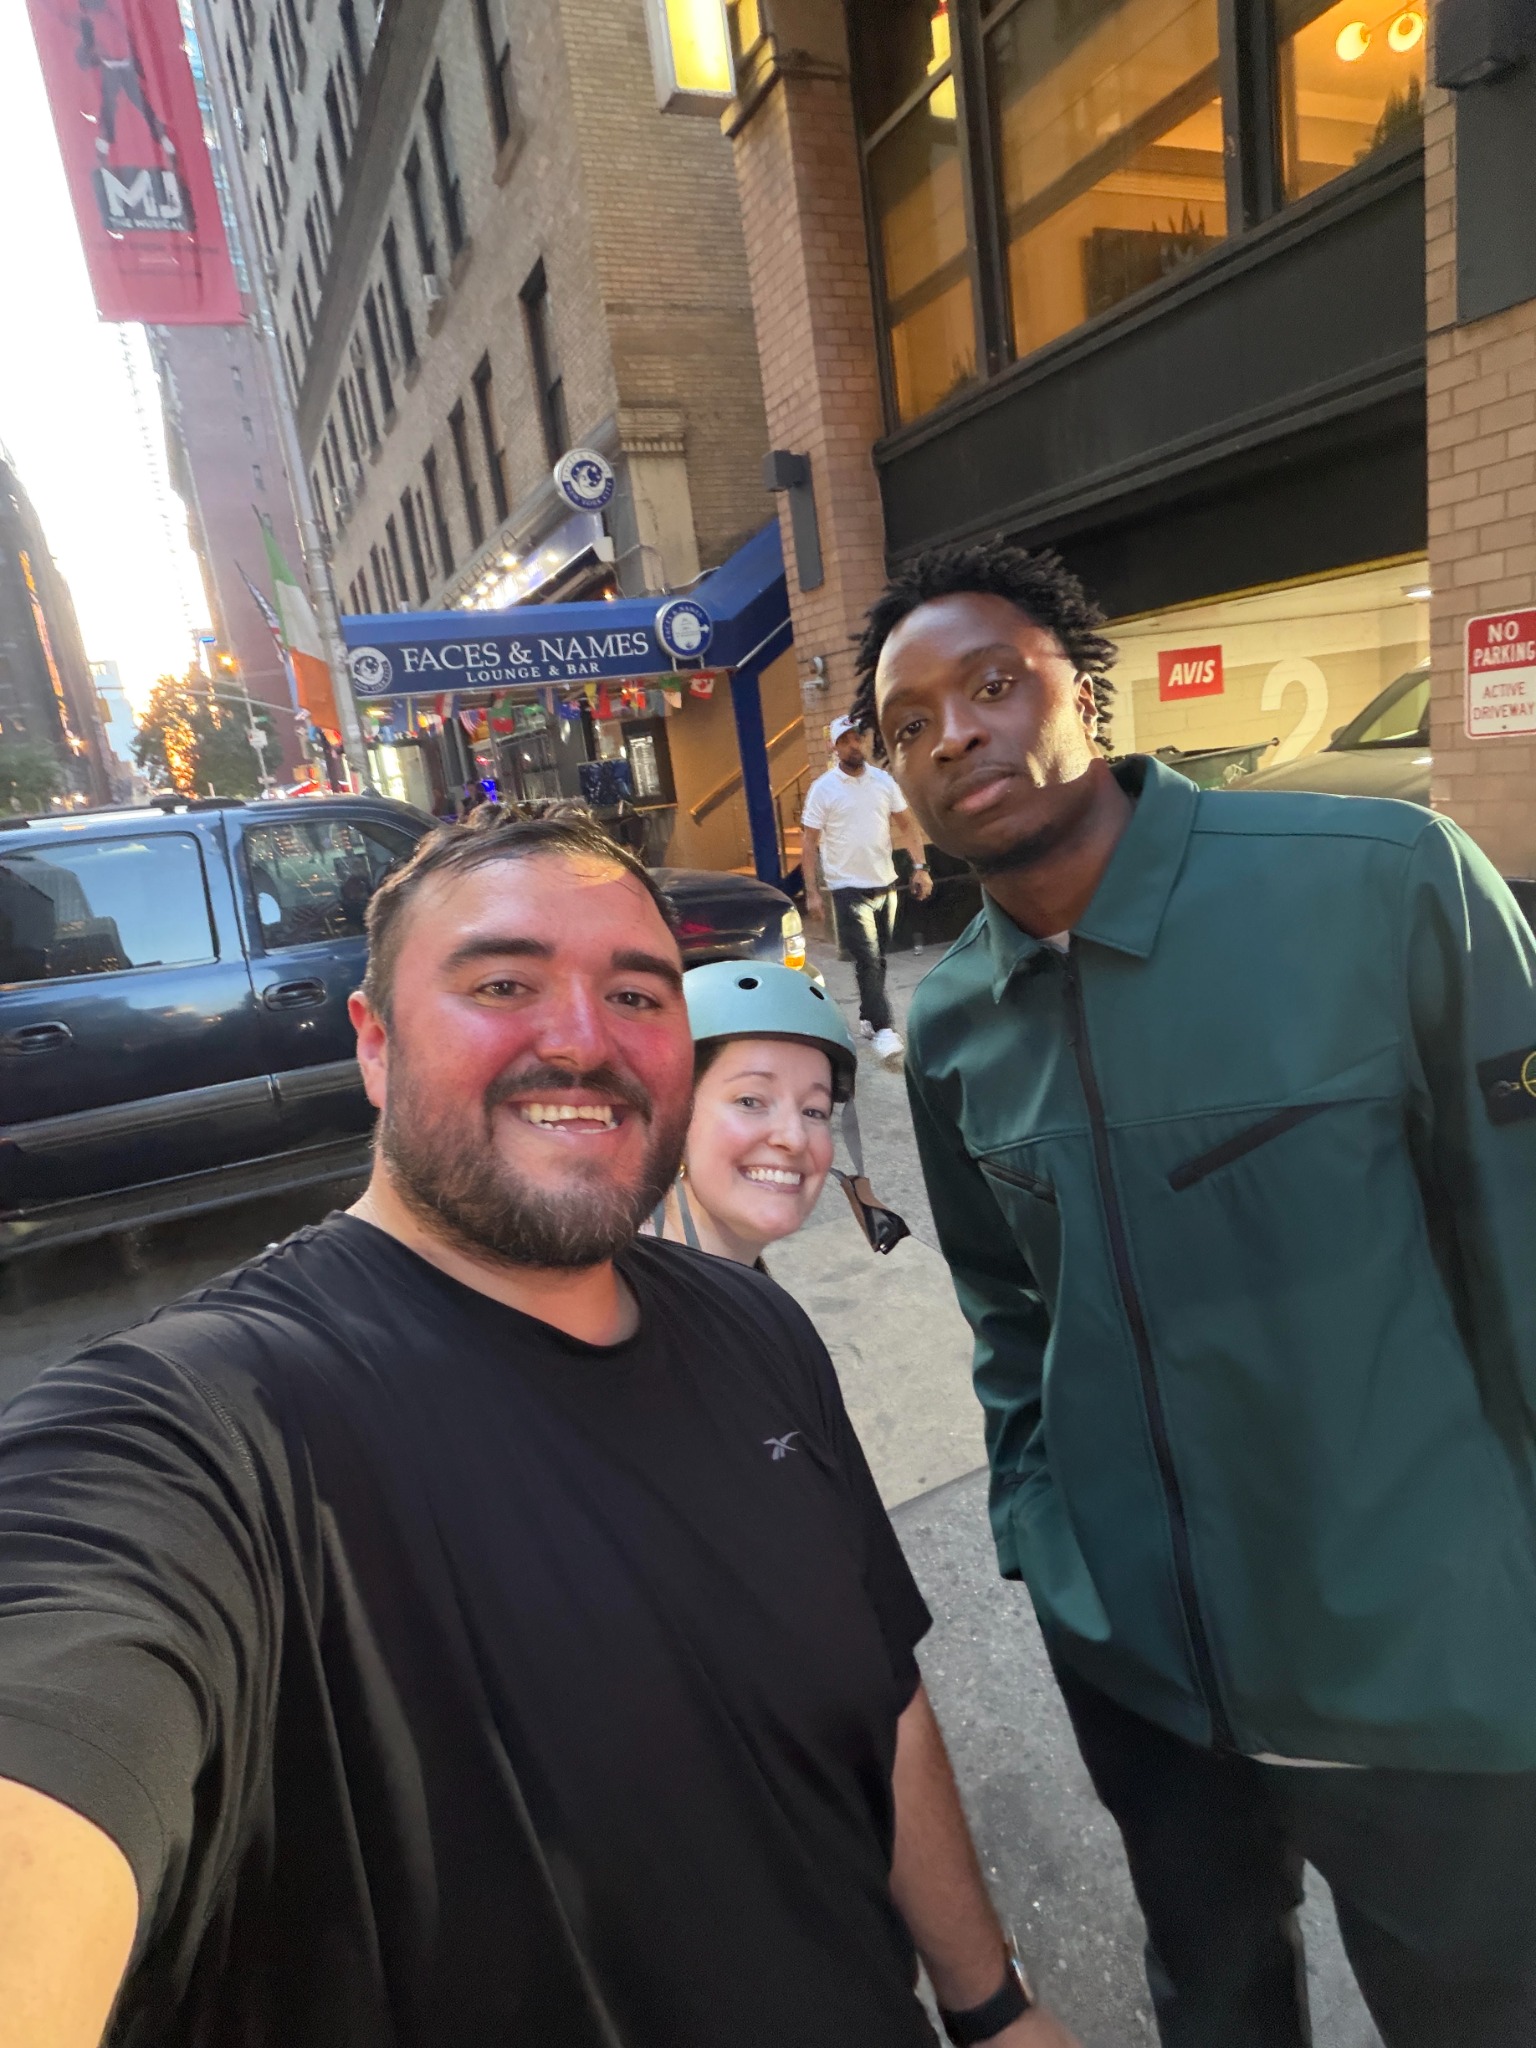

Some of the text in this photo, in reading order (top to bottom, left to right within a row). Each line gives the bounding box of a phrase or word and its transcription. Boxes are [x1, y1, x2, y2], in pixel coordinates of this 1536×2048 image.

[100, 167, 183, 219] MJ
[1487, 620, 1519, 643] NO
[399, 642, 501, 673] FACES
[508, 641, 533, 665] &
[538, 632, 649, 662] NAMES
[1473, 640, 1536, 667] PARKING
[466, 662, 601, 683] LOUNGE & BAR
[1168, 659, 1216, 687] AVIS
[1483, 681, 1526, 699] ACTIVE
[1261, 657, 1329, 766] 2
[1473, 702, 1535, 720] DRIVEWAY
